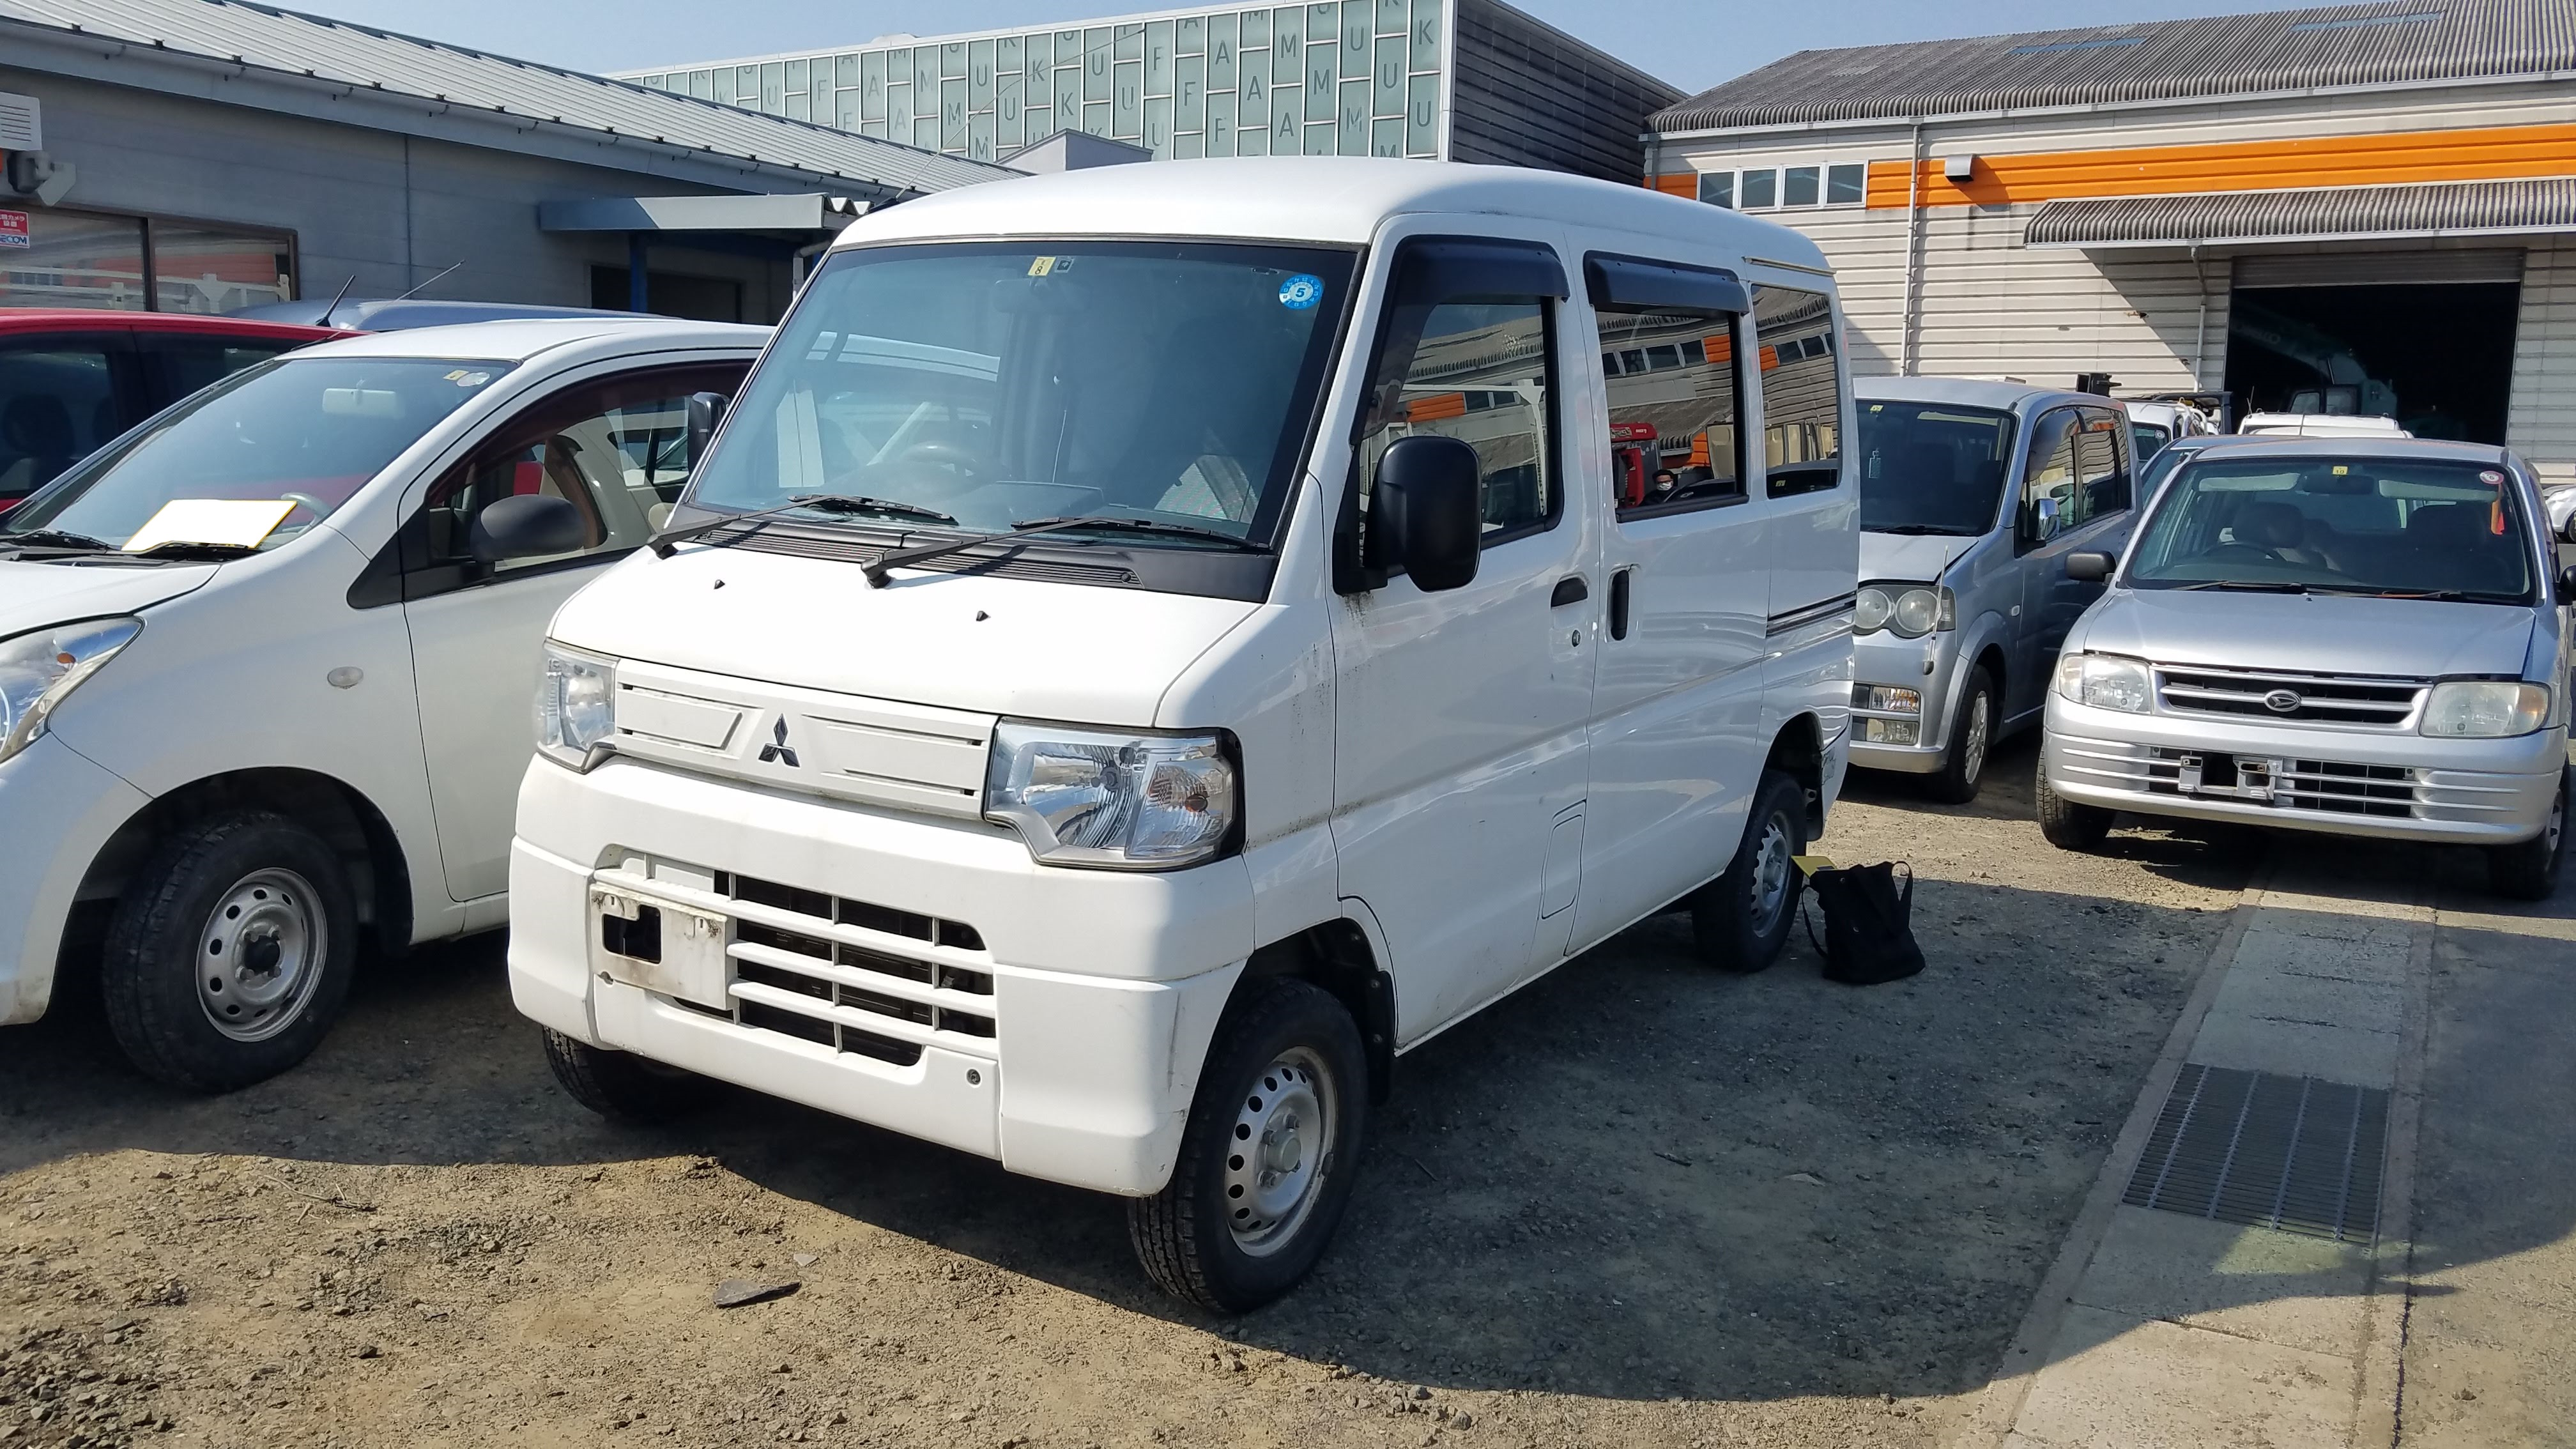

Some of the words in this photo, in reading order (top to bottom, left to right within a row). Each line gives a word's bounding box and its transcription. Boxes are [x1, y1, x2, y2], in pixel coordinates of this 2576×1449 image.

[817, 79, 827, 101] F
[868, 75, 879, 96] A
[976, 64, 988, 87] U
[1032, 59, 1045, 82] K
[1092, 52, 1103, 75] U
[1153, 47, 1162, 70] F
[1215, 40, 1230, 65] A
[1281, 34, 1296, 58] M
[1350, 26, 1364, 51] U
[1418, 19, 1434, 45] K
[948, 102, 960, 125] M
[1004, 97, 1015, 121] U
[1061, 92, 1073, 116] K
[1122, 86, 1133, 110] U
[1184, 82, 1195, 106] F
[1247, 75, 1262, 100] A
[1314, 69, 1330, 95] M
[1383, 63, 1397, 89] U
[976, 136, 988, 159] M
[1215, 118, 1226, 142] F
[1279, 112, 1294, 137] A
[1416, 100, 1431, 127] U
[0, 234, 27, 244] ECOM
[1034, 266, 1043, 275] 8
[1296, 288, 1306, 298] 5
